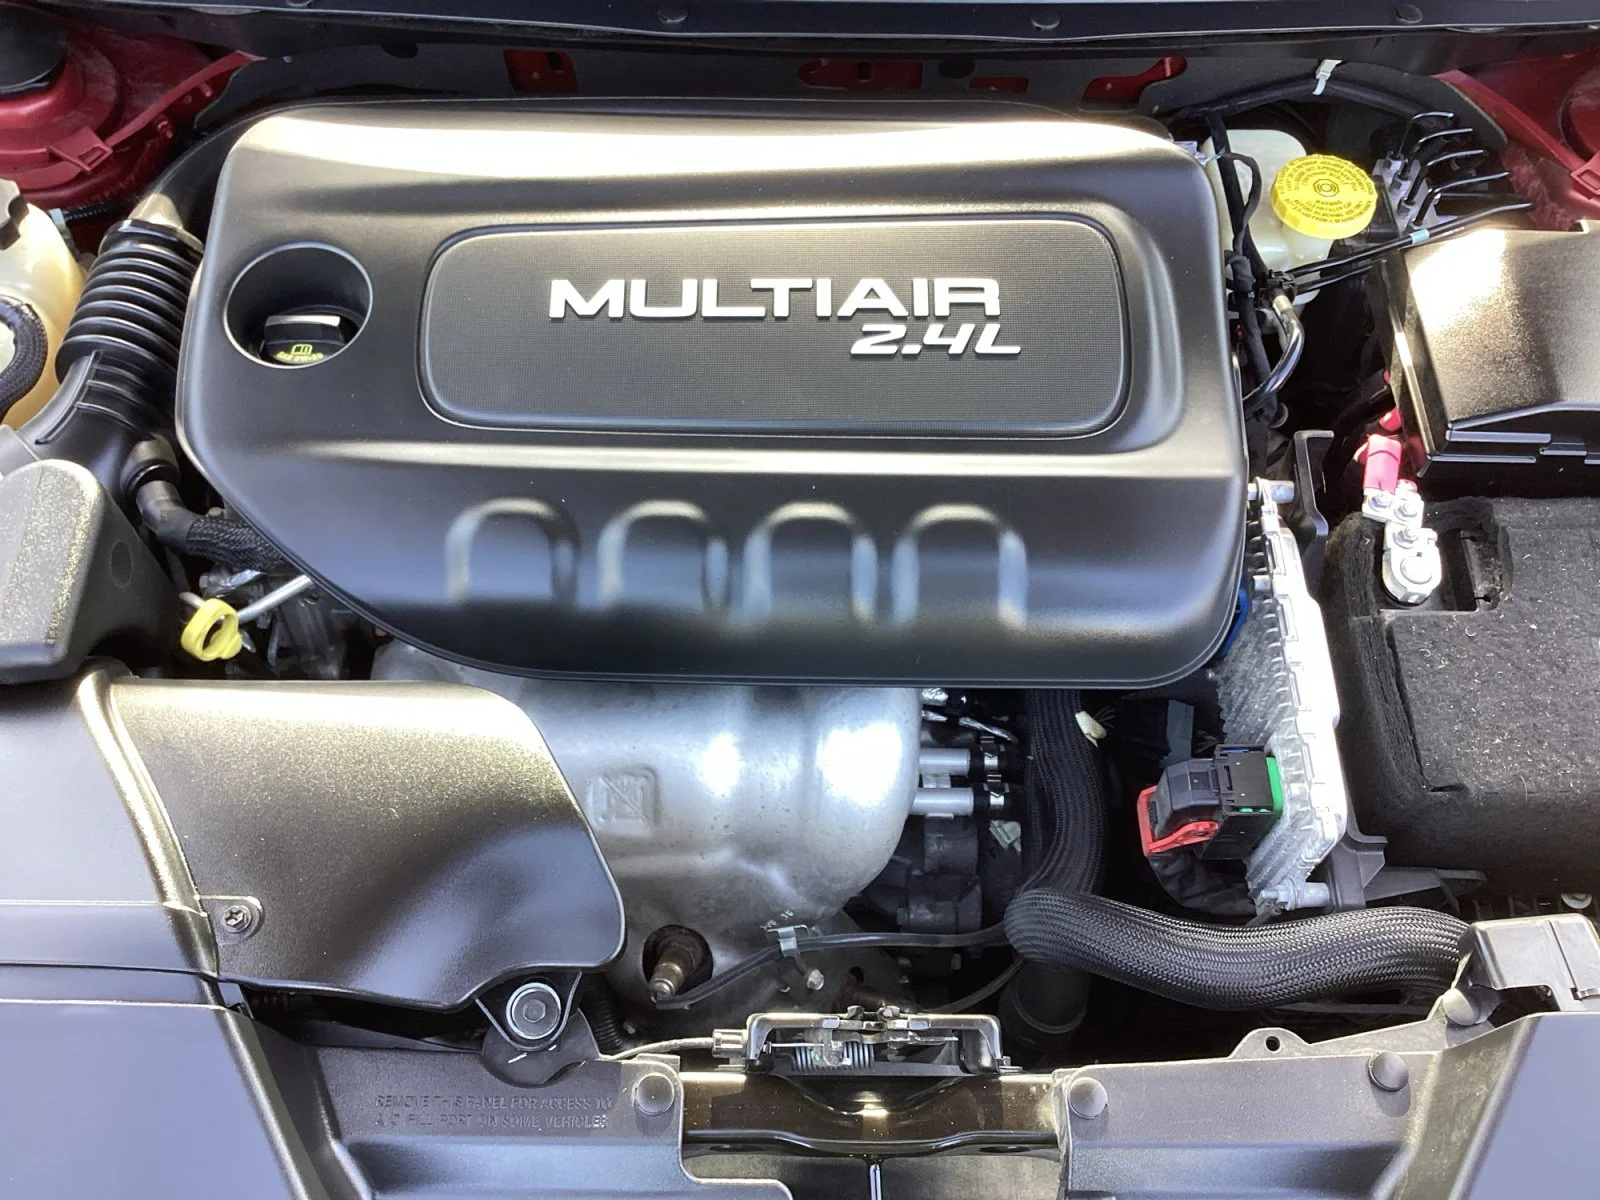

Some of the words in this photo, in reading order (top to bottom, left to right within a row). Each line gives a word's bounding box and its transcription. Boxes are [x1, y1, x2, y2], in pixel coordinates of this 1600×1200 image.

[549, 278, 1001, 320] MULTIAIR
[850, 323, 1022, 356] 2.4L
[375, 1095, 430, 1108] REMOVE
[433, 1095, 464, 1109] THIS
[466, 1095, 508, 1110] PANEL
[511, 1095, 538, 1110] FOR
[540, 1095, 592, 1111] ACCESS
[407, 1114, 433, 1126] FILL
[440, 1114, 473, 1127] PORT
[478, 1115, 498, 1128] ON
[502, 1115, 540, 1128] SOME
[545, 1114, 609, 1129] VEHICLES
